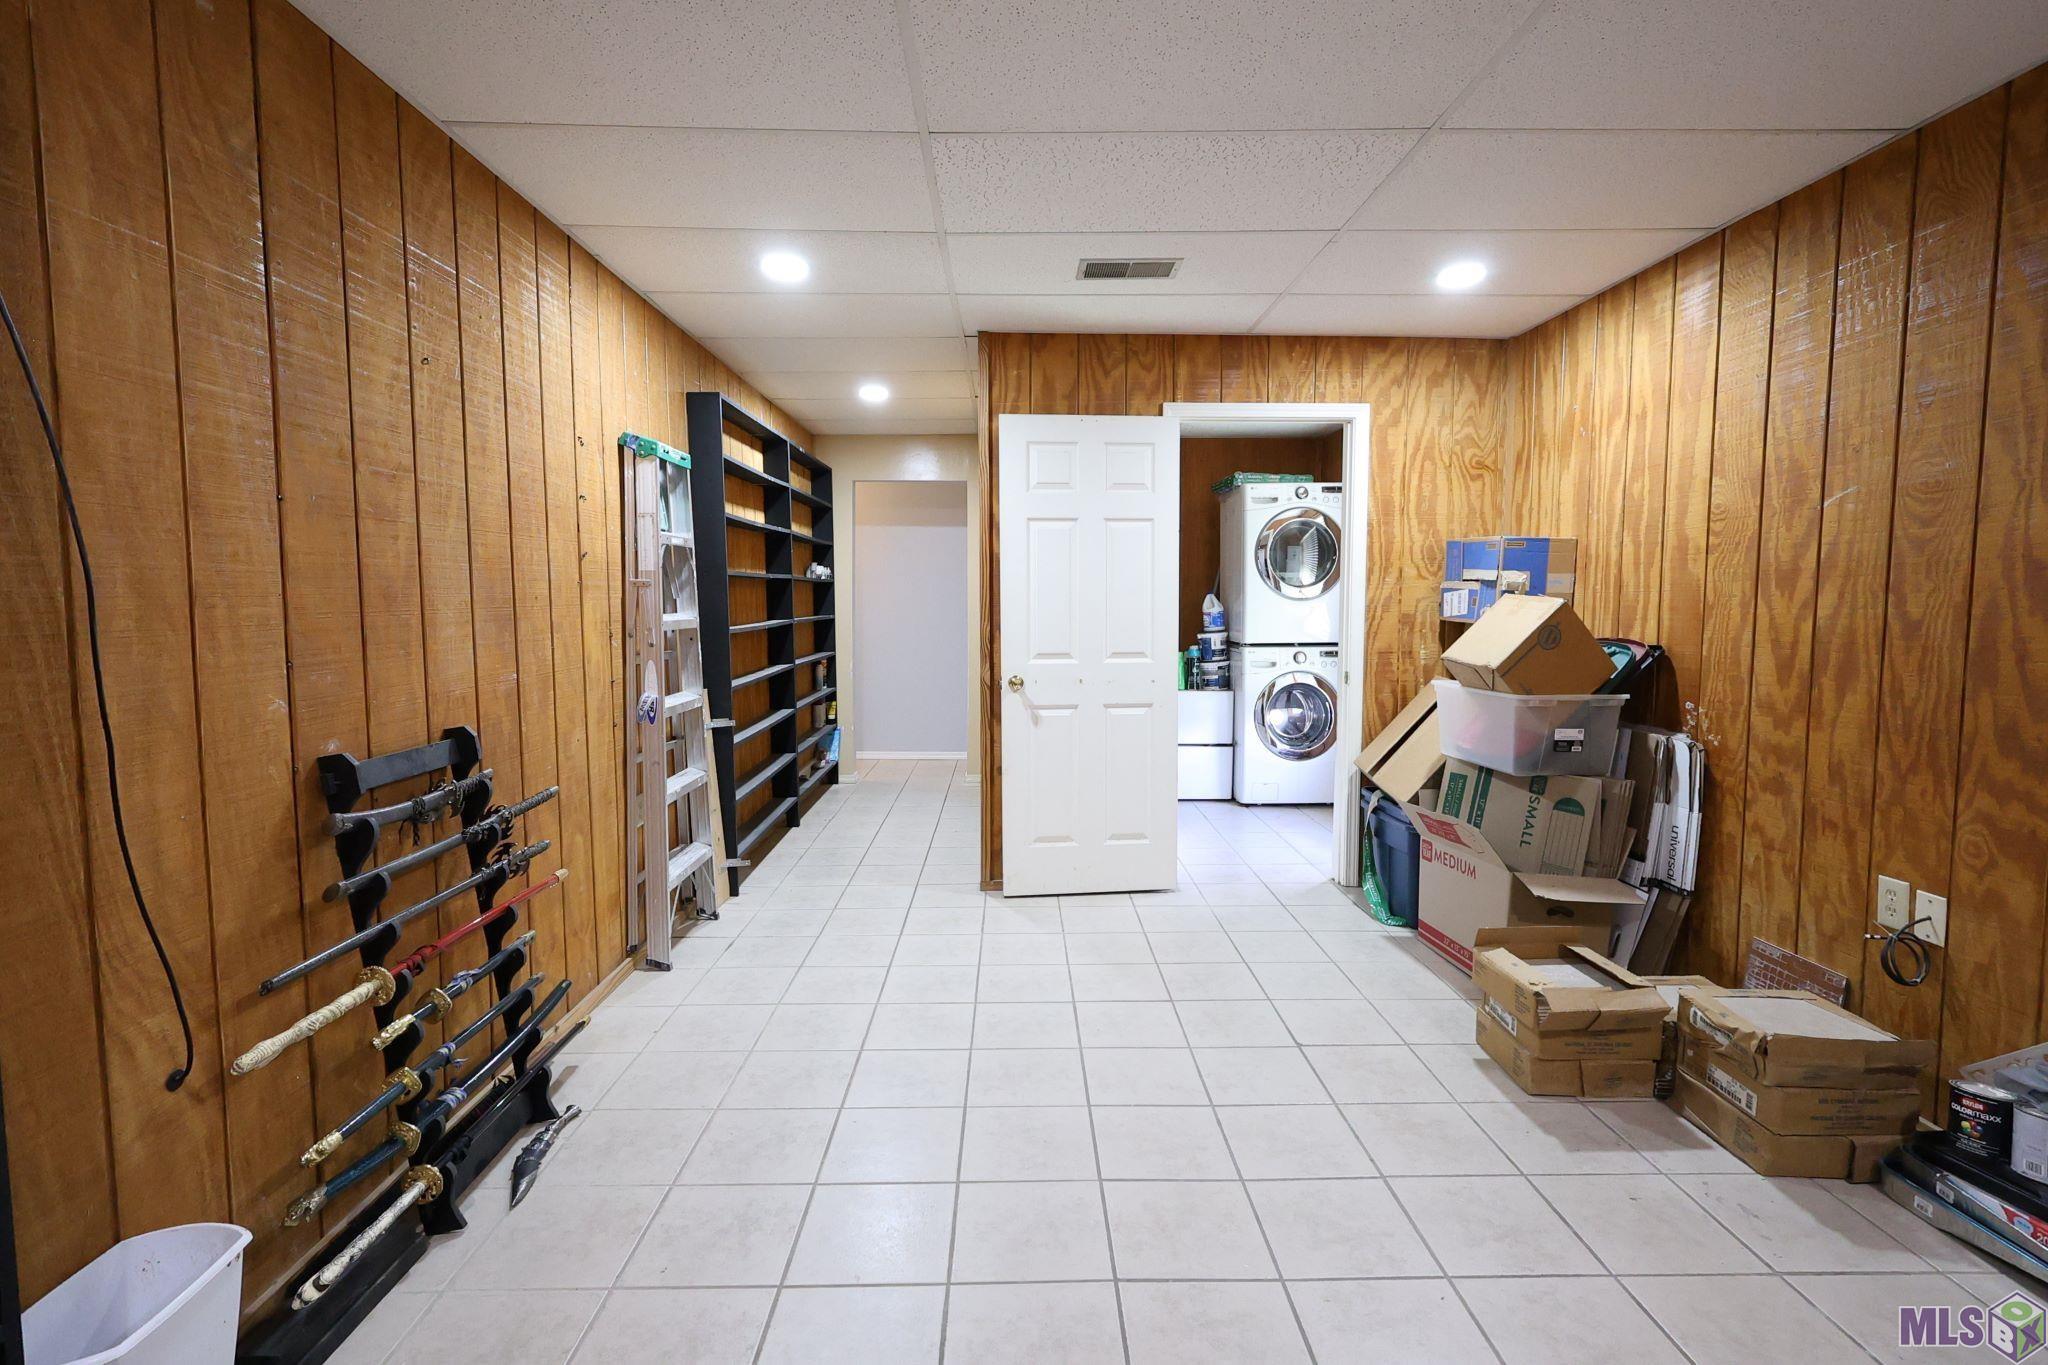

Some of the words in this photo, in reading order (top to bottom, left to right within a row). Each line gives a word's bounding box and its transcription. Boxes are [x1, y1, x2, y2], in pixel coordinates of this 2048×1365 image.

[1520, 795, 1540, 848] SMALL
[1434, 848, 1476, 880] MEDIUM
[1667, 825, 1679, 882] universal
